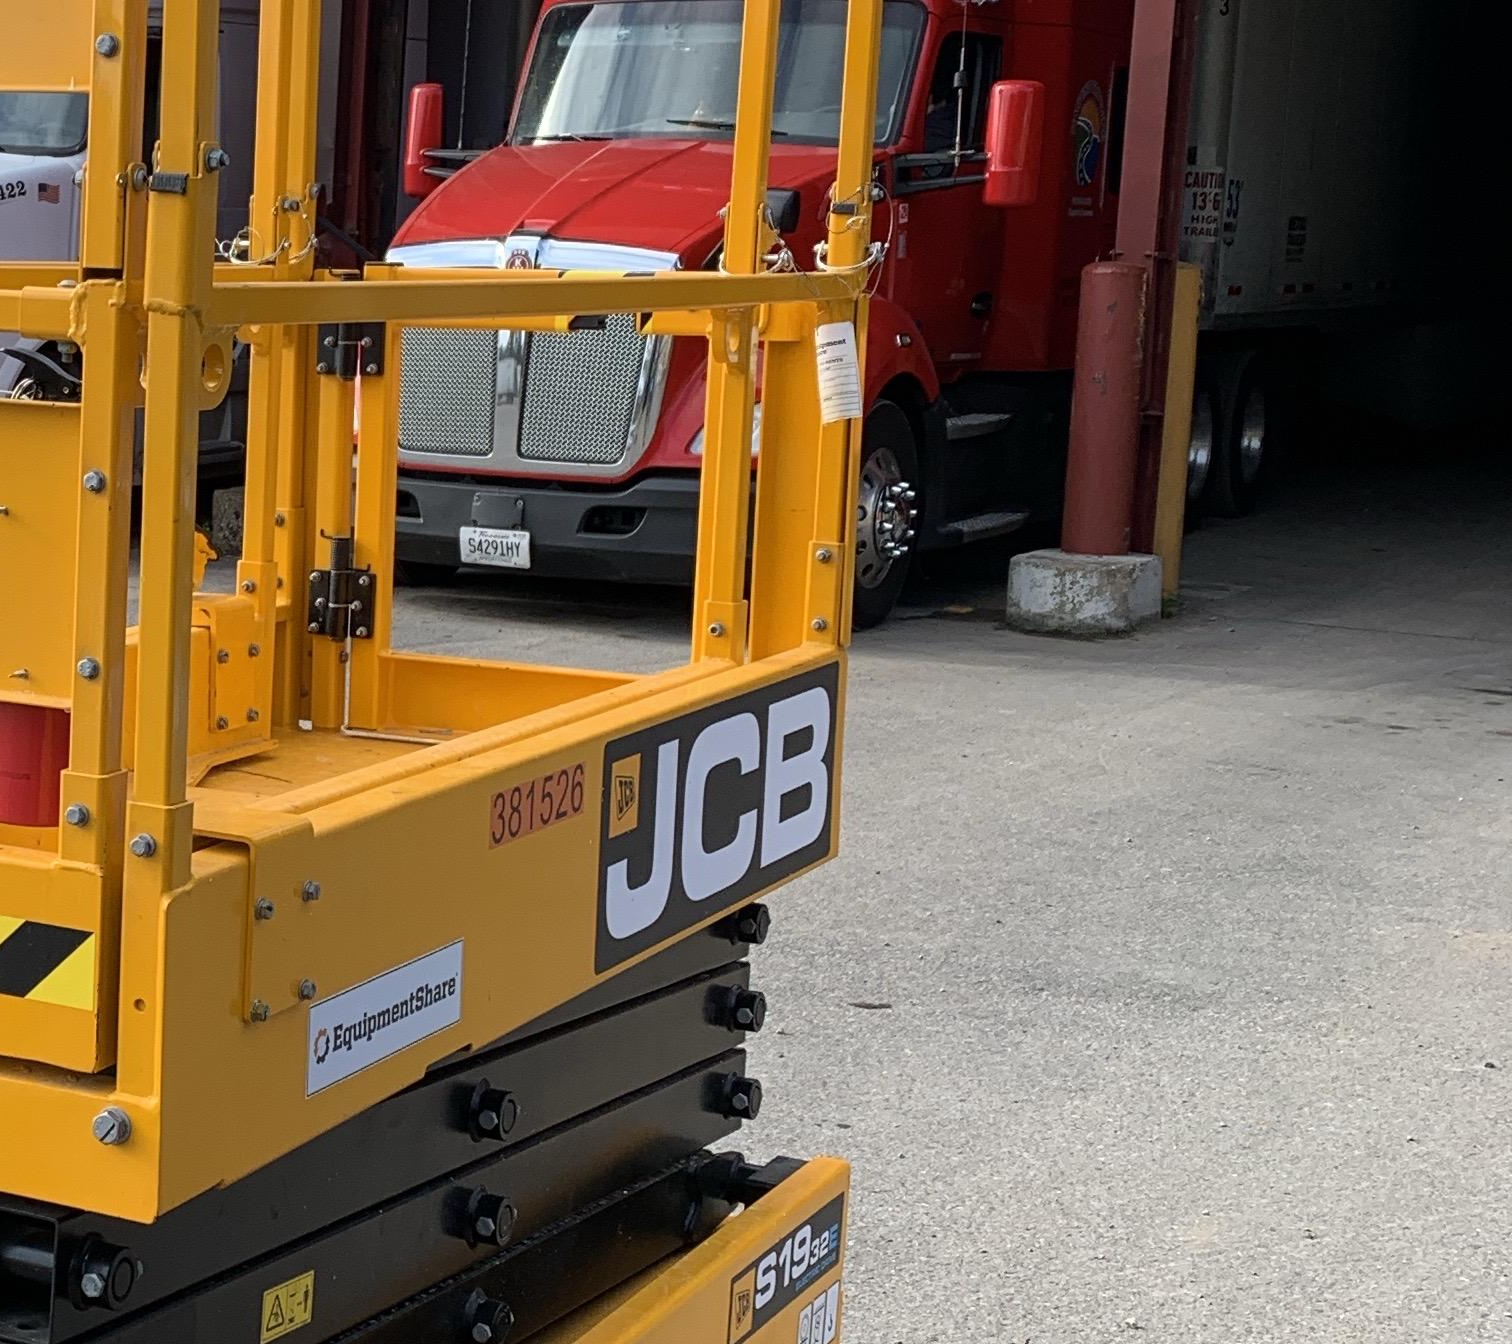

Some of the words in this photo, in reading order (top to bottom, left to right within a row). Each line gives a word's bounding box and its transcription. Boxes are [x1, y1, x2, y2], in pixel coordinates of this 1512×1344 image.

[468, 538, 520, 557] S4291HY
[491, 763, 584, 844] 381526
[606, 686, 831, 940] JCB
[332, 975, 457, 1052] EquipmentShare
